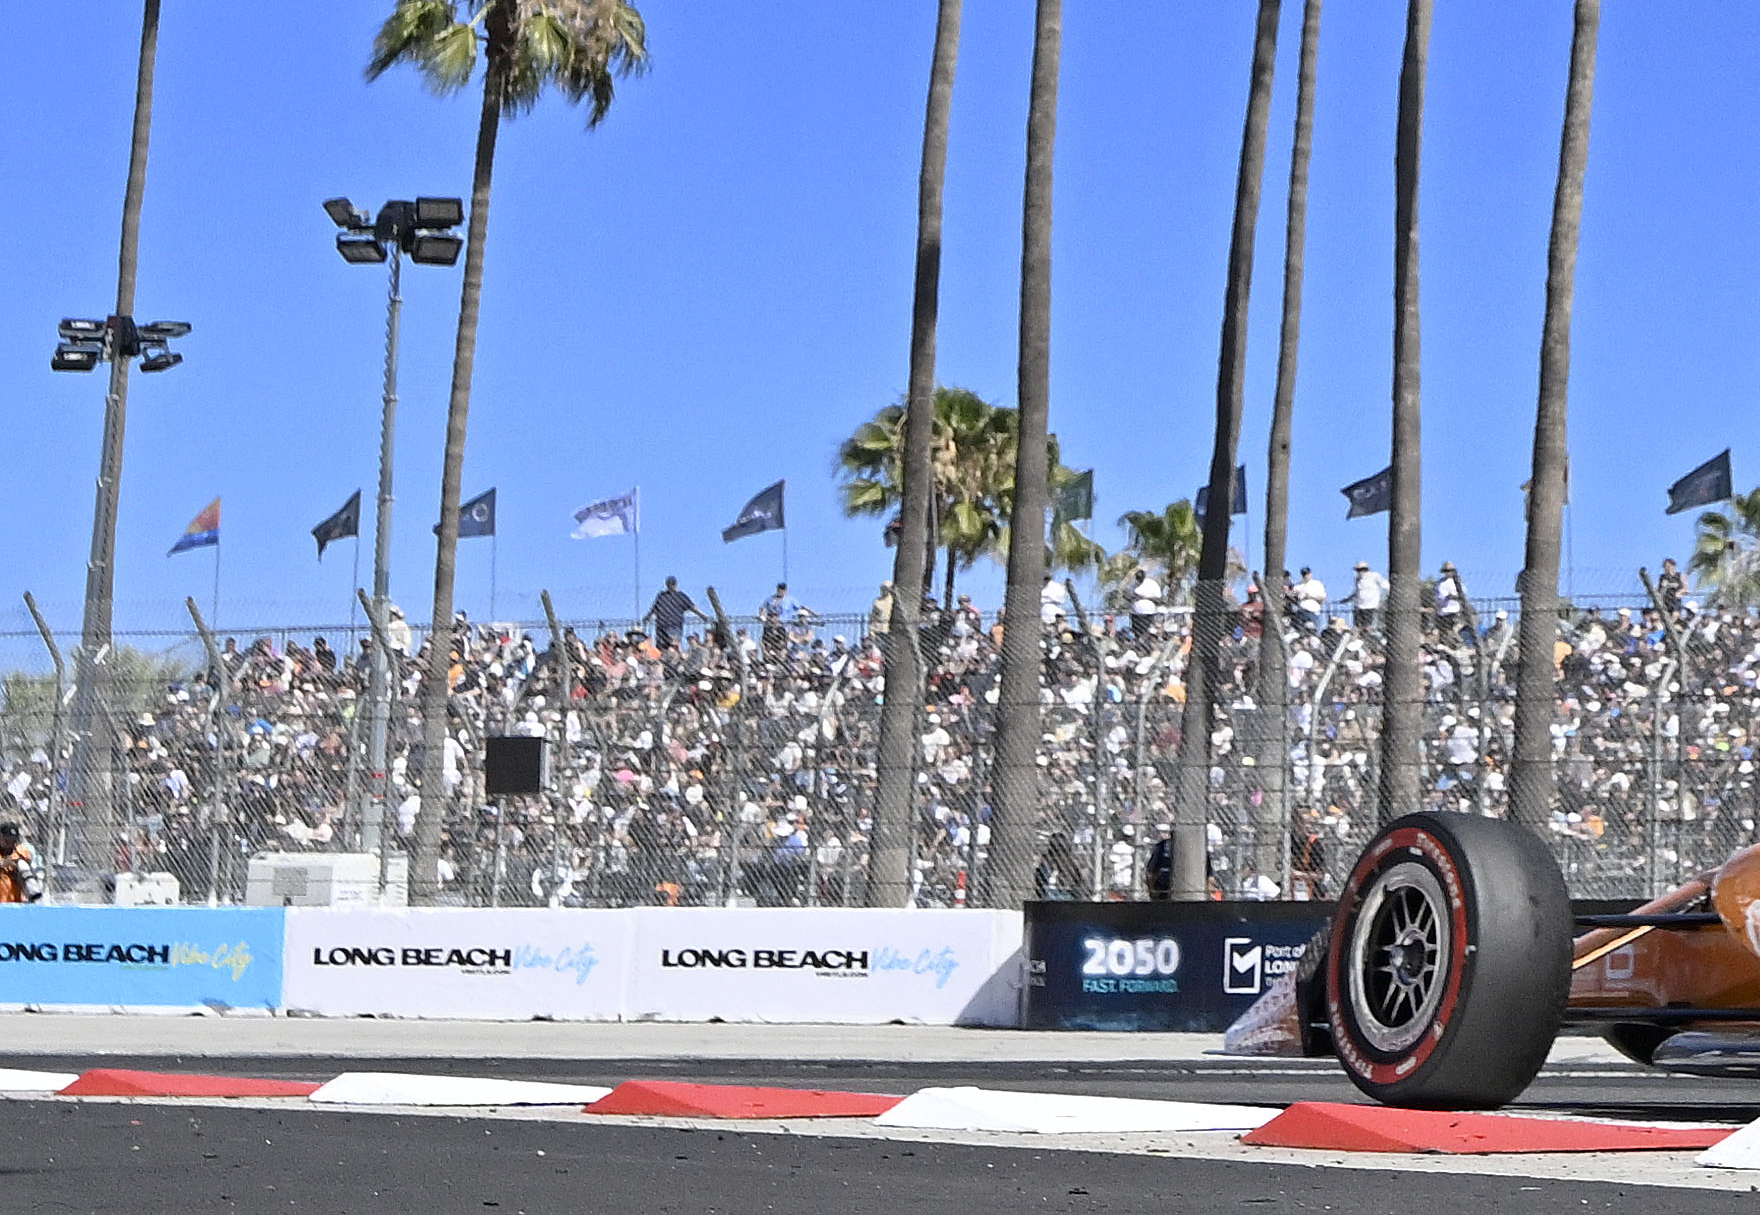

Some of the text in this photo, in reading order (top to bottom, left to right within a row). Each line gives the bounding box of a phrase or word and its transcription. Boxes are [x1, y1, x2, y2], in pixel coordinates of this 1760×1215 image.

[0, 942, 58, 962] ONG
[63, 943, 170, 964] BEACH
[313, 947, 396, 966] LONG
[401, 948, 511, 967] BEACH
[662, 948, 747, 968] LONG
[753, 949, 868, 969] BEACH
[1082, 938, 1181, 975] 2050
